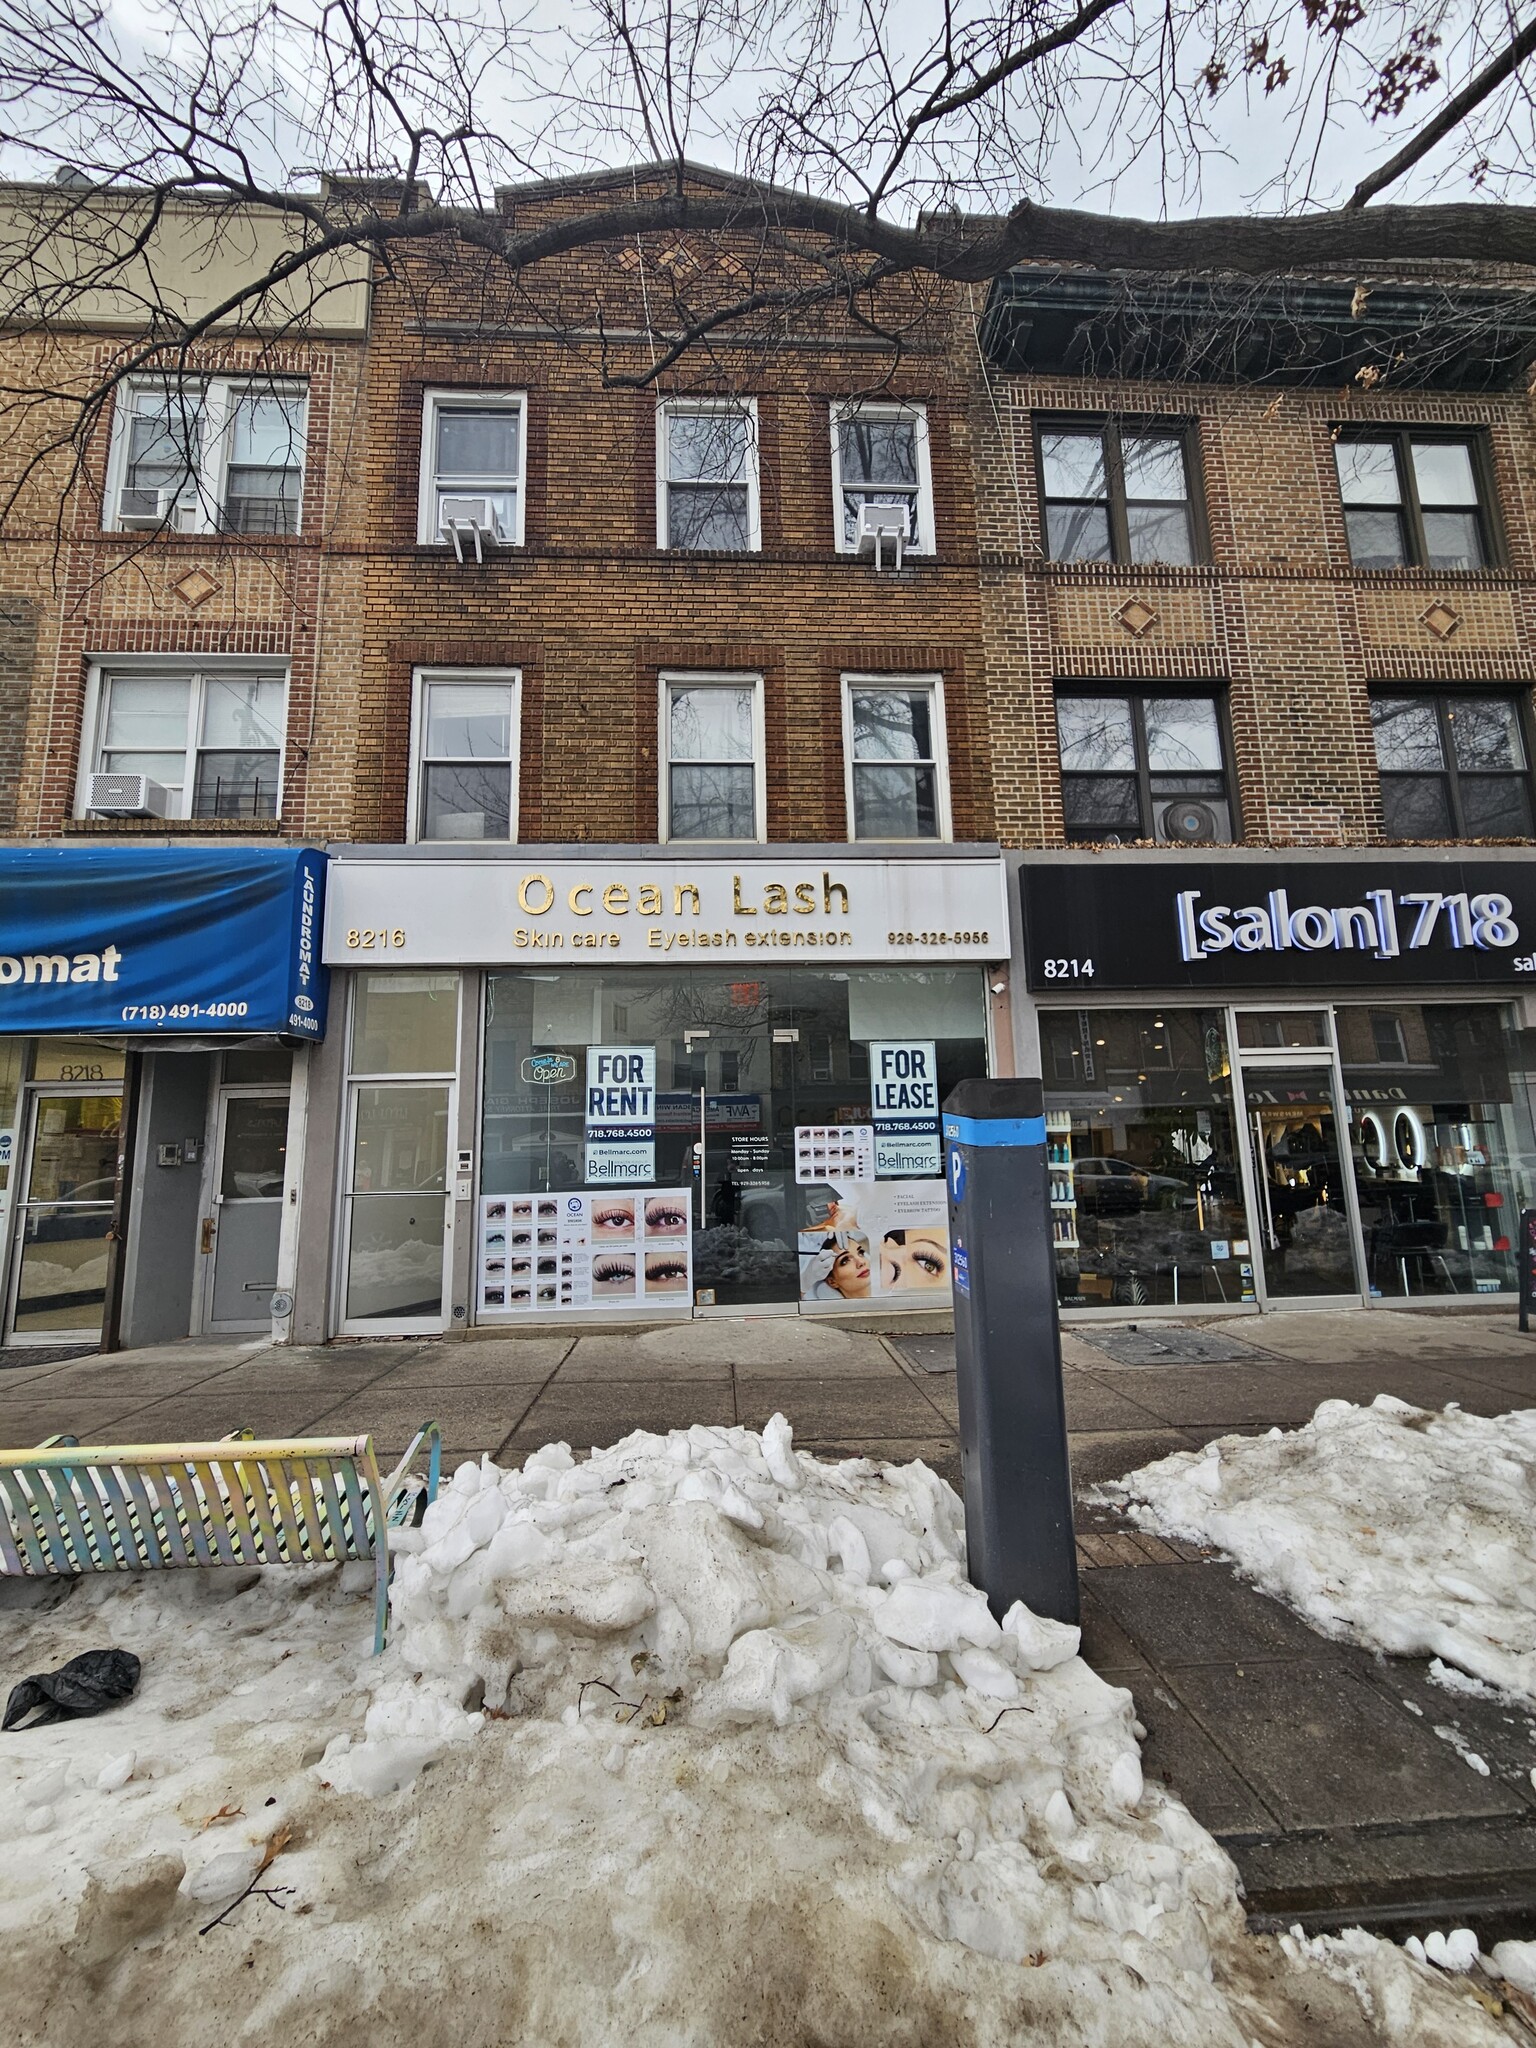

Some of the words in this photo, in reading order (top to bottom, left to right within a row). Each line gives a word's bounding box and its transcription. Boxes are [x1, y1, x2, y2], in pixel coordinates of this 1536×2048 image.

[517, 873, 700, 916] Ocean
[733, 871, 849, 915] Lash
[299, 866, 315, 986] LAUNDROMAT
[1400, 892, 1519, 950] 718
[346, 928, 406, 948] 8216
[513, 928, 564, 947] Skin
[570, 931, 621, 947] care
[647, 928, 738, 951] Eyelash
[744, 929, 852, 947] extension
[887, 931, 990, 945] 929-326-5956
[0, 944, 122, 984] omat
[1044, 958, 1095, 978] 8214
[121, 1004, 166, 1021] (718)
[168, 1002, 248, 1019] 491-4000
[289, 1013, 319, 1031] 491-4000
[60, 1064, 104, 1081] 8218
[597, 1054, 644, 1084] FOR
[881, 1049, 926, 1079] FOR
[533, 1066, 566, 1083] Open
[588, 1087, 653, 1117] RENT
[875, 1083, 935, 1110] LEASE
[588, 1128, 652, 1138] 718.768.4500
[875, 1121, 936, 1131] 718.768.4500
[588, 1160, 652, 1176] Bellmarc
[878, 1152, 937, 1168] Bellmarc
[952, 1151, 961, 1195] P
